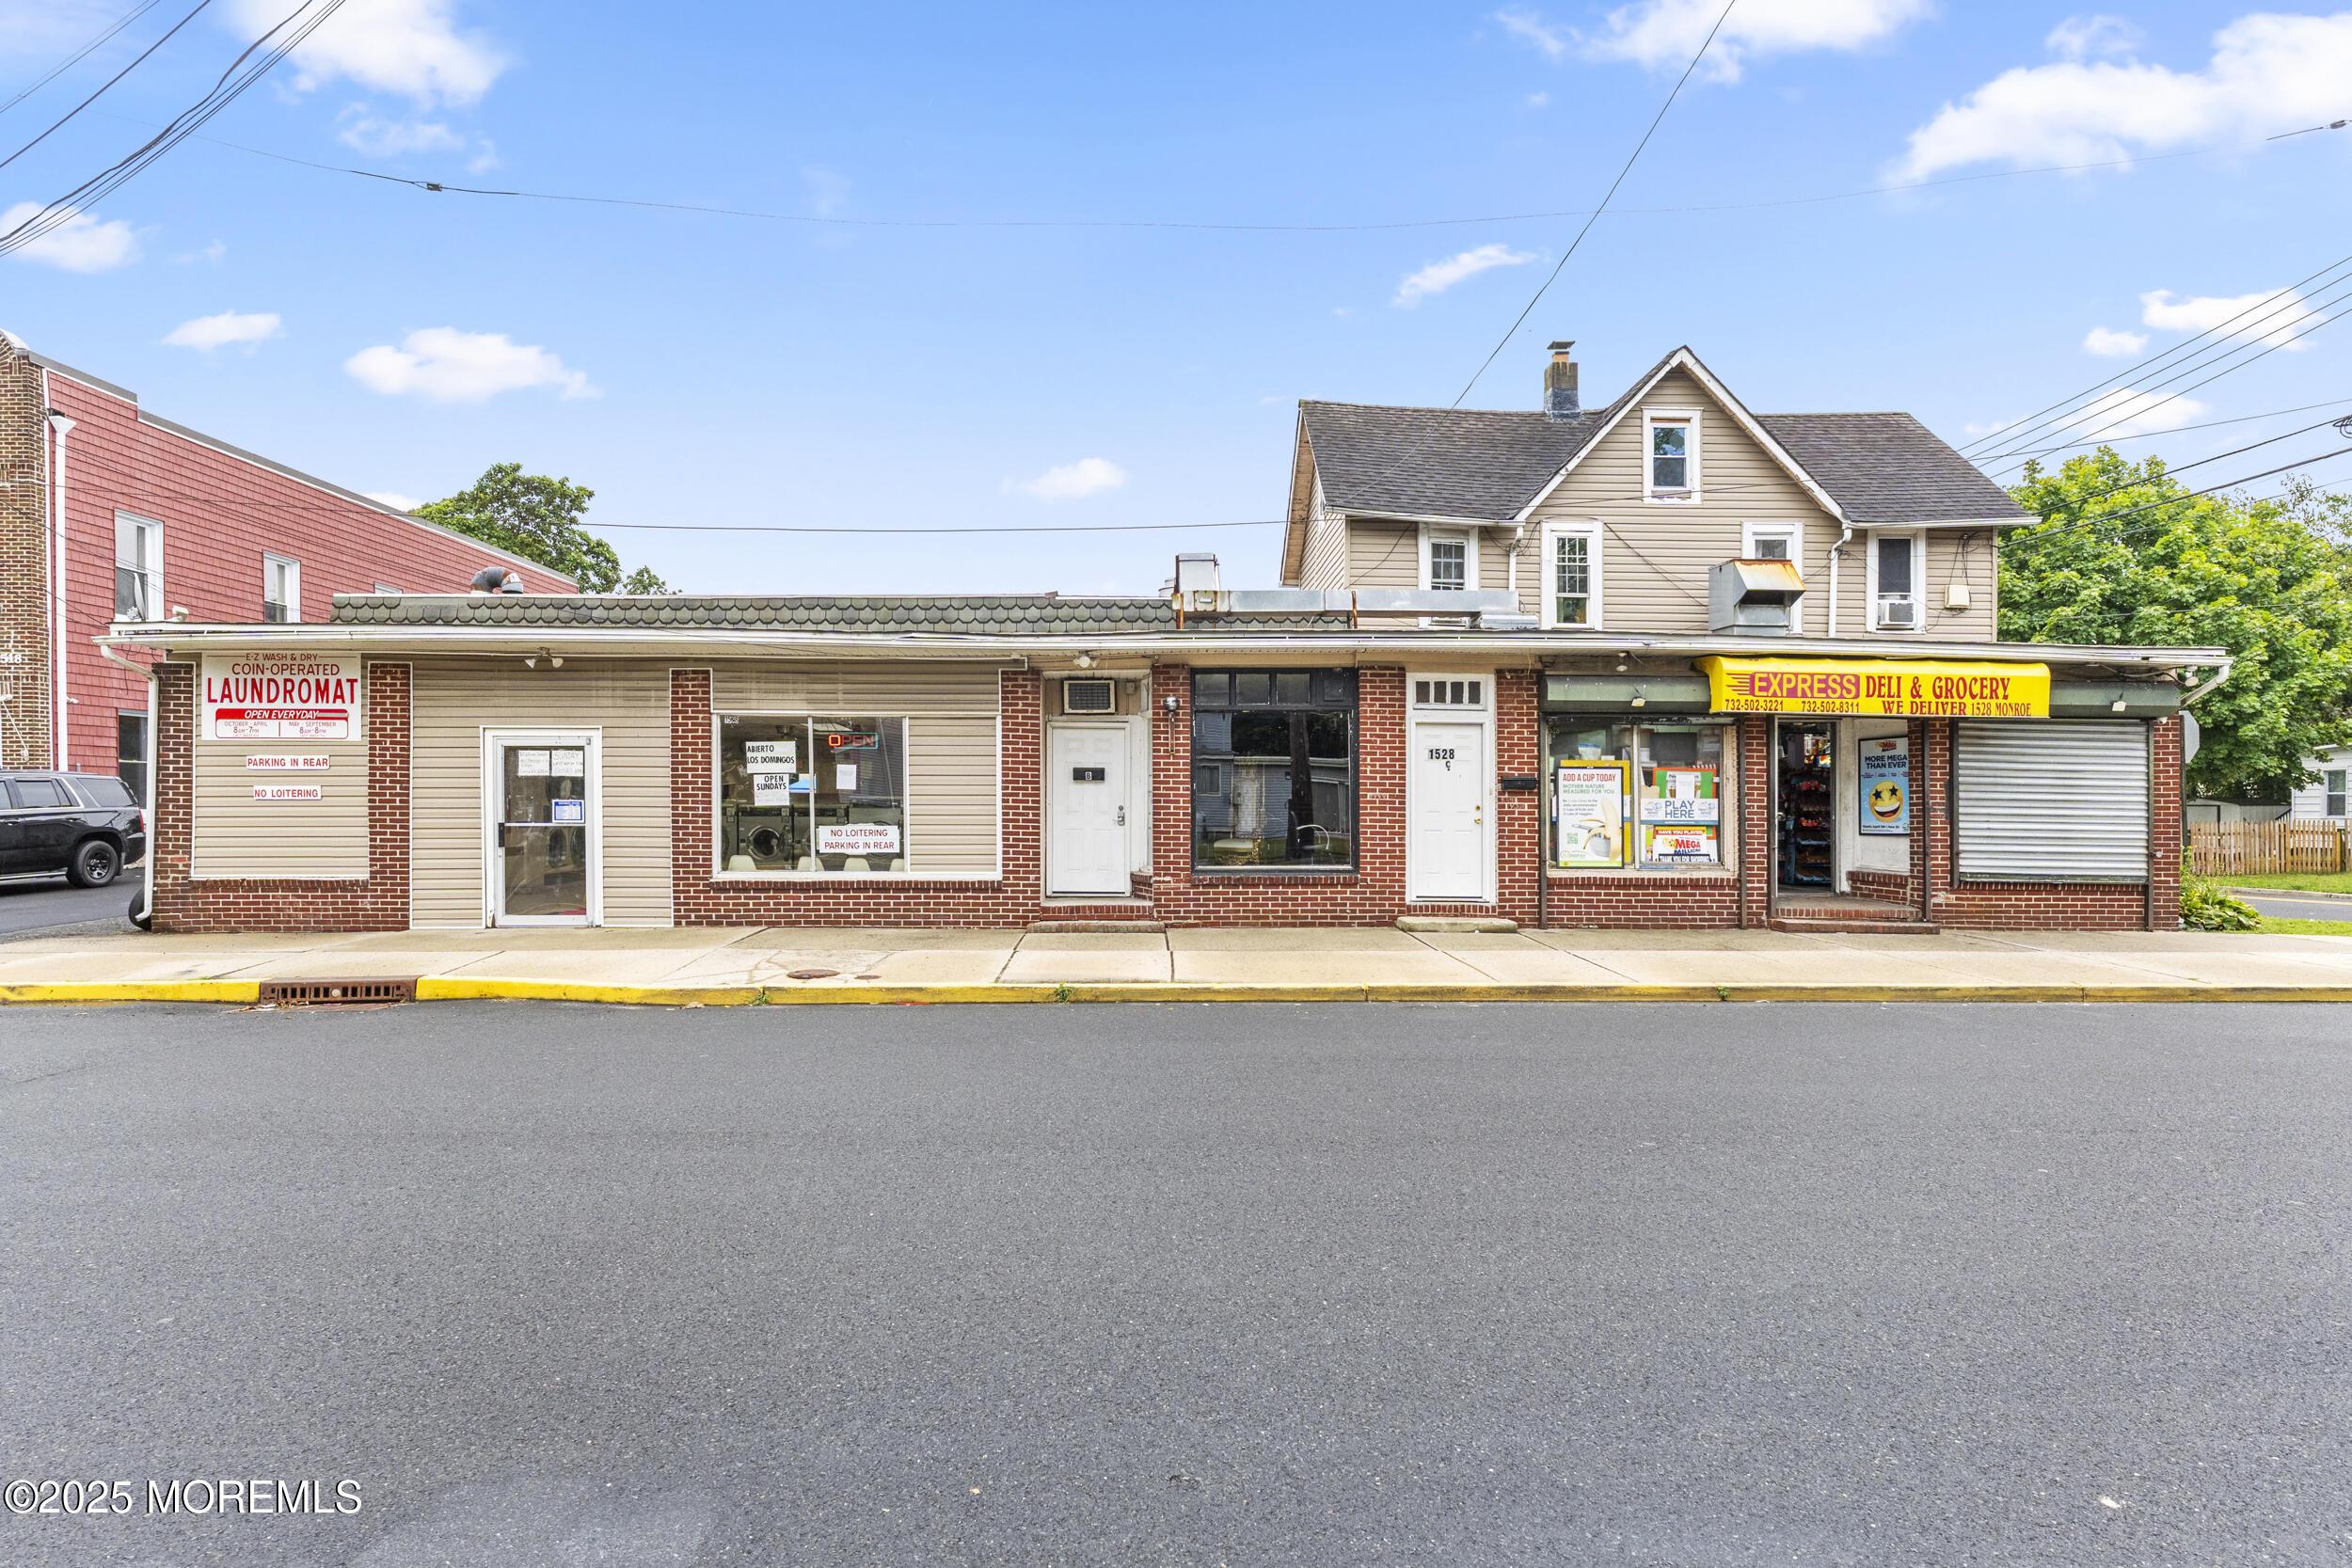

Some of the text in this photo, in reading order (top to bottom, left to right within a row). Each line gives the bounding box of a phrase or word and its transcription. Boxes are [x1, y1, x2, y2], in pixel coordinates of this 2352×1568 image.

[231, 663, 340, 676] COIN-OPERATED
[207, 677, 358, 704] LAUNDROMAT
[1754, 673, 2010, 701] EXPRESS DELI & GROCERY
[1724, 699, 2031, 717] 732-502-3221 732-502-8311 WE DELIVER 1528 MONROE
[245, 710, 319, 720] OPEN EVERYDAY
[828, 734, 874, 747] OPEN
[746, 744, 775, 752] ABIERTO
[1428, 749, 1454, 760] 1528
[247, 758, 328, 767] PARKING IN REAR
[1563, 773, 1616, 782] ADD A CUP TODAY
[756, 783, 787, 791] SUNDAYS
[254, 789, 319, 798] NO LOITERING
[1664, 800, 1694, 809] PLAY
[1664, 809, 1694, 818] HERE
[831, 829, 888, 837] NO LOITERING
[1675, 838, 1701, 849] MEGA
